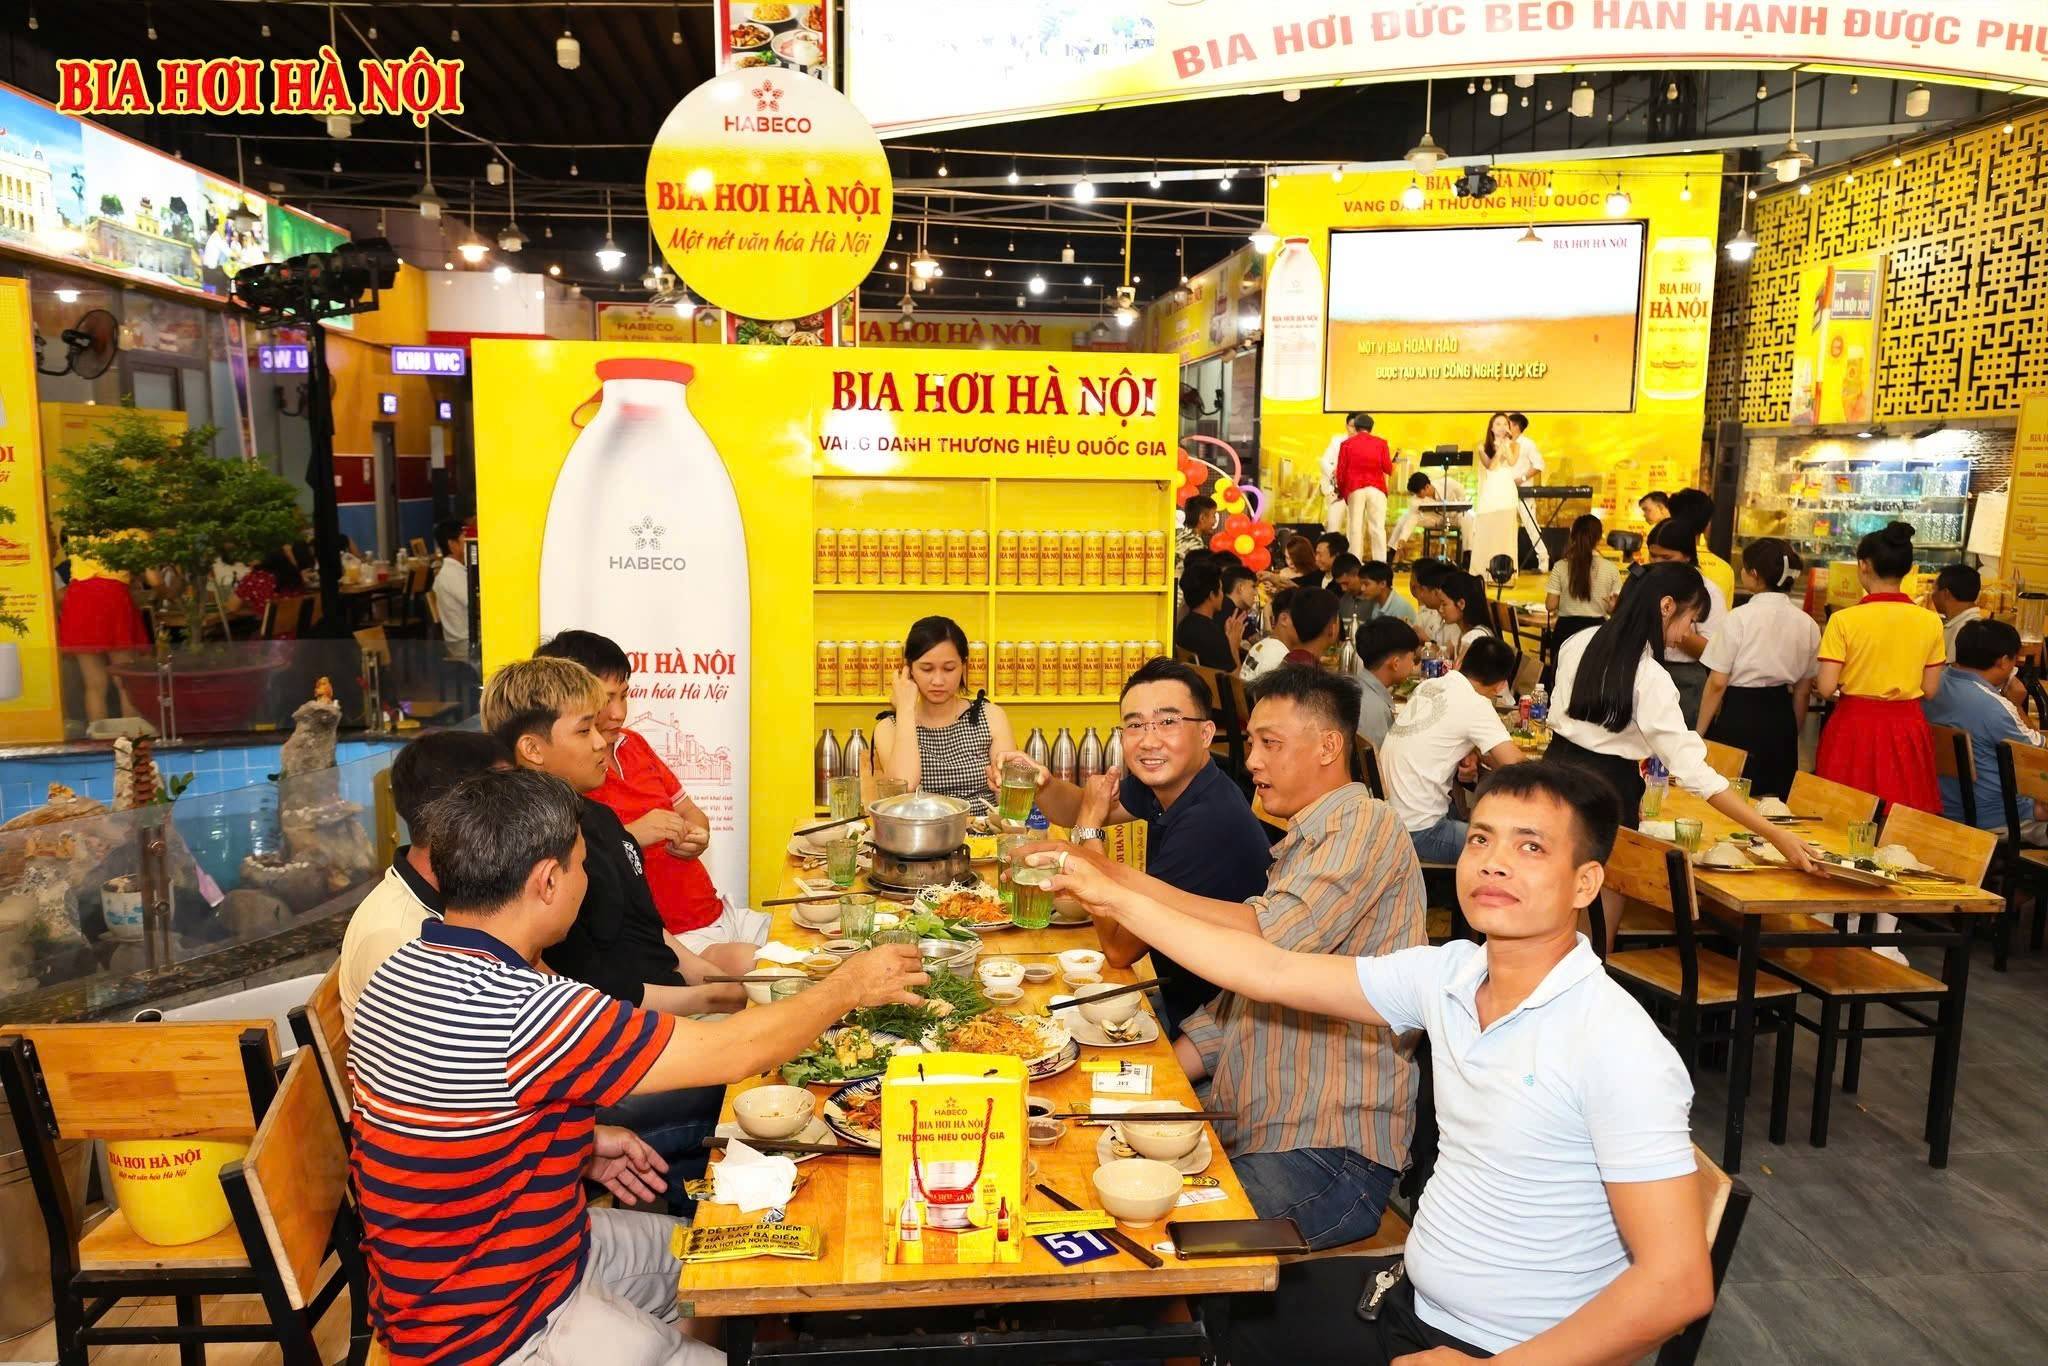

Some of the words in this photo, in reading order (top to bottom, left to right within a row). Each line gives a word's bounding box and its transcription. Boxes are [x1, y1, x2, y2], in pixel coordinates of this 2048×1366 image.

[1173, 33, 1257, 79] BIA
[1273, 14, 1353, 56] HƠI
[1371, 2, 1466, 42] ĐỨC
[1705, 2, 1828, 39] HẠNH
[1844, 8, 1960, 48] ĐƯỢC
[724, 116, 812, 133] HABECO
[656, 181, 706, 212] BIA
[714, 182, 770, 213] HƠI
[777, 178, 822, 214] HÀ
[827, 180, 881, 222] NỘI
[1344, 200, 1385, 213] VANG
[667, 228, 704, 254] Một
[707, 229, 735, 250] nét
[738, 231, 768, 252] văn
[774, 229, 805, 251] hóa
[809, 230, 836, 253] Hà
[839, 232, 873, 258] Nội
[1659, 282, 1678, 295] BIA
[1649, 297, 1673, 319] HÀ
[1677, 296, 1709, 323] NỘI
[617, 323, 674, 332] HABECO
[888, 320, 942, 343] HƠI
[946, 317, 986, 345] HÀ
[396, 351, 431, 371] KHU
[434, 352, 461, 372] WC
[1472, 361, 1501, 381] NGHỆ
[1504, 363, 1525, 381] LỌC
[832, 370, 905, 412] BIA
[914, 371, 995, 414] HƠI
[1006, 365, 1068, 416] HÀ
[1078, 366, 1157, 428] NỘI
[878, 436, 931, 453] DANH
[938, 437, 1020, 455] THƯƠNG
[1026, 436, 1071, 458] HIỆU
[1076, 434, 1130, 457] QUỐC
[1136, 439, 1167, 456] GIA
[609, 556, 687, 571] HABECO
[626, 652, 649, 674] ƠI
[654, 647, 689, 675] HÀ
[693, 649, 736, 681] NỘI
[626, 685, 648, 699] văn
[651, 682, 676, 700] hóa
[680, 683, 700, 700] Hà
[704, 685, 730, 703] Nội
[919, 1120, 933, 1129] BIA
[989, 1131, 1005, 1140] GIA
[123, 1156, 145, 1169] HƠI
[150, 1153, 171, 1169] HÀ
[173, 1149, 201, 1168] NỘI
[163, 1170, 173, 1179] Hà
[1044, 1231, 1107, 1258] 51
